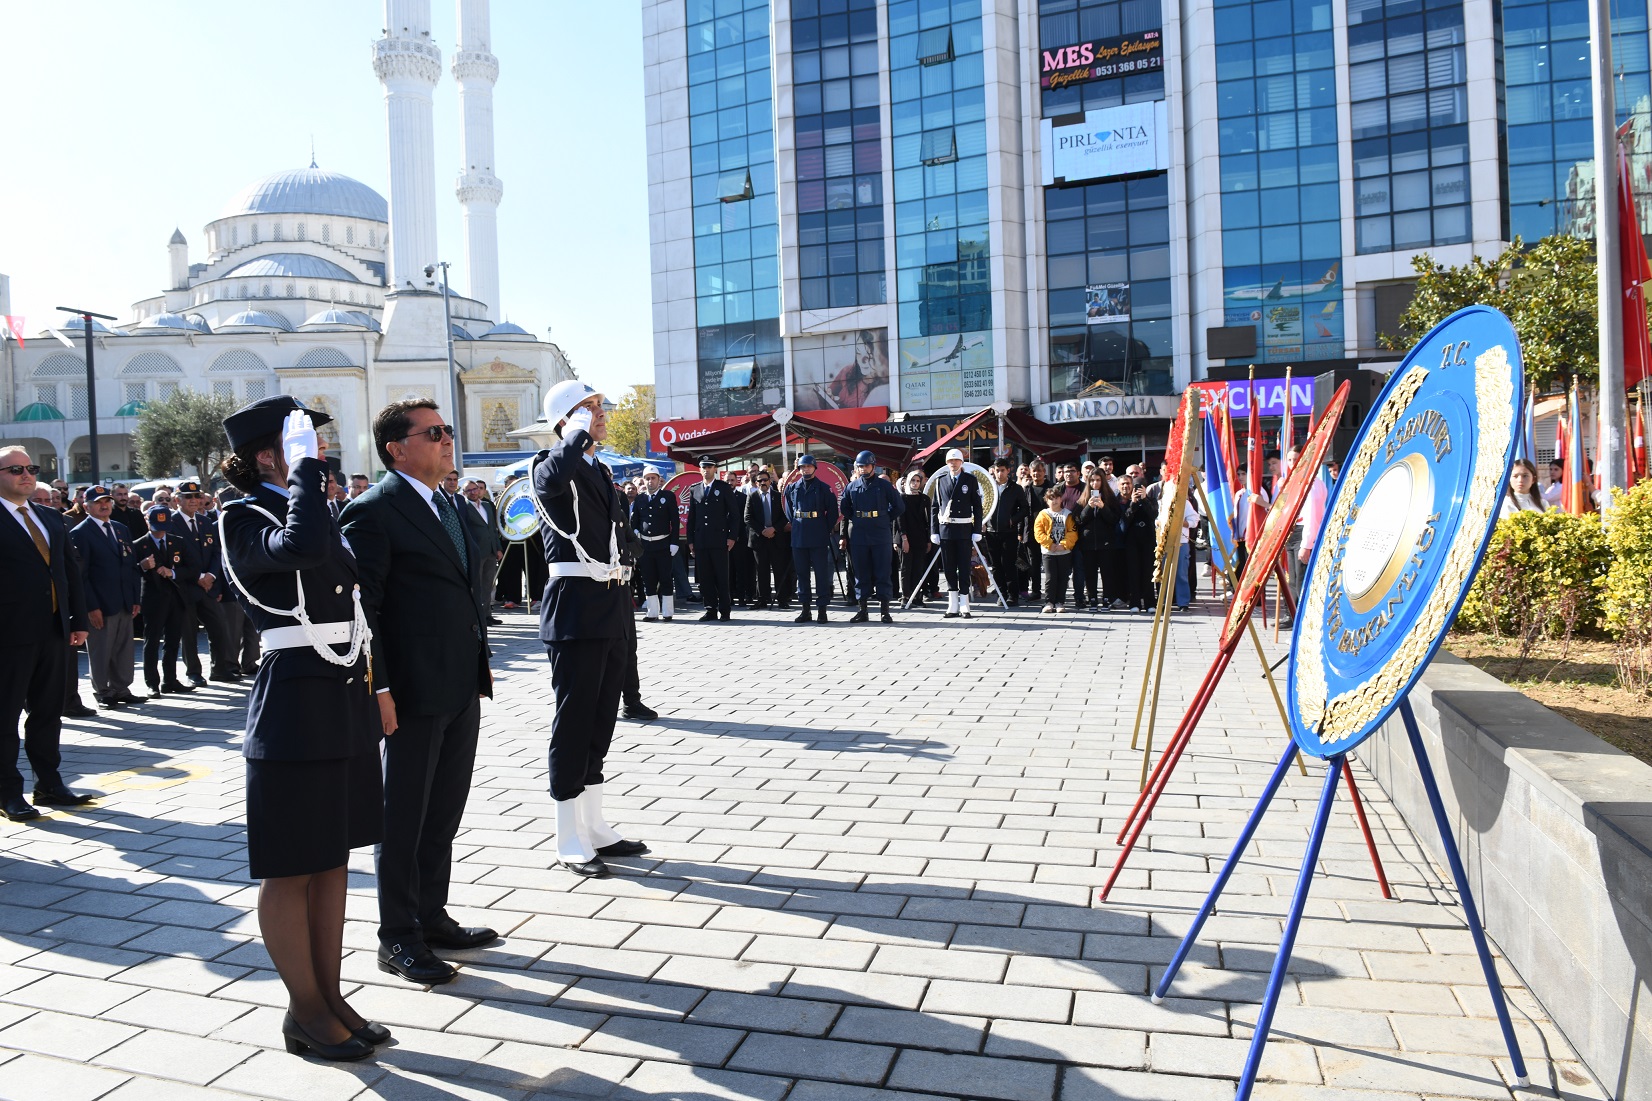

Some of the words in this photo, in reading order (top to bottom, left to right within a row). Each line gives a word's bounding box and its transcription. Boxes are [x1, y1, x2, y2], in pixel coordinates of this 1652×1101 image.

[1043, 42, 1095, 72] MES
[1096, 45, 1119, 60] Lazer
[1120, 40, 1160, 56] Epilasyon
[1095, 64, 1117, 77] 0531
[1119, 61, 1135, 73] 368
[1136, 59, 1148, 69] 05
[1150, 56, 1161, 67] 21
[1049, 67, 1090, 88] Güzellik
[1084, 143, 1113, 156] güzellik
[1115, 139, 1149, 151] esenyurt
[905, 381, 926, 390] QATAR
[1048, 397, 1158, 422] PANAROMIA
[884, 423, 933, 434] HAREKET
[1384, 408, 1453, 464] ESENYURT
